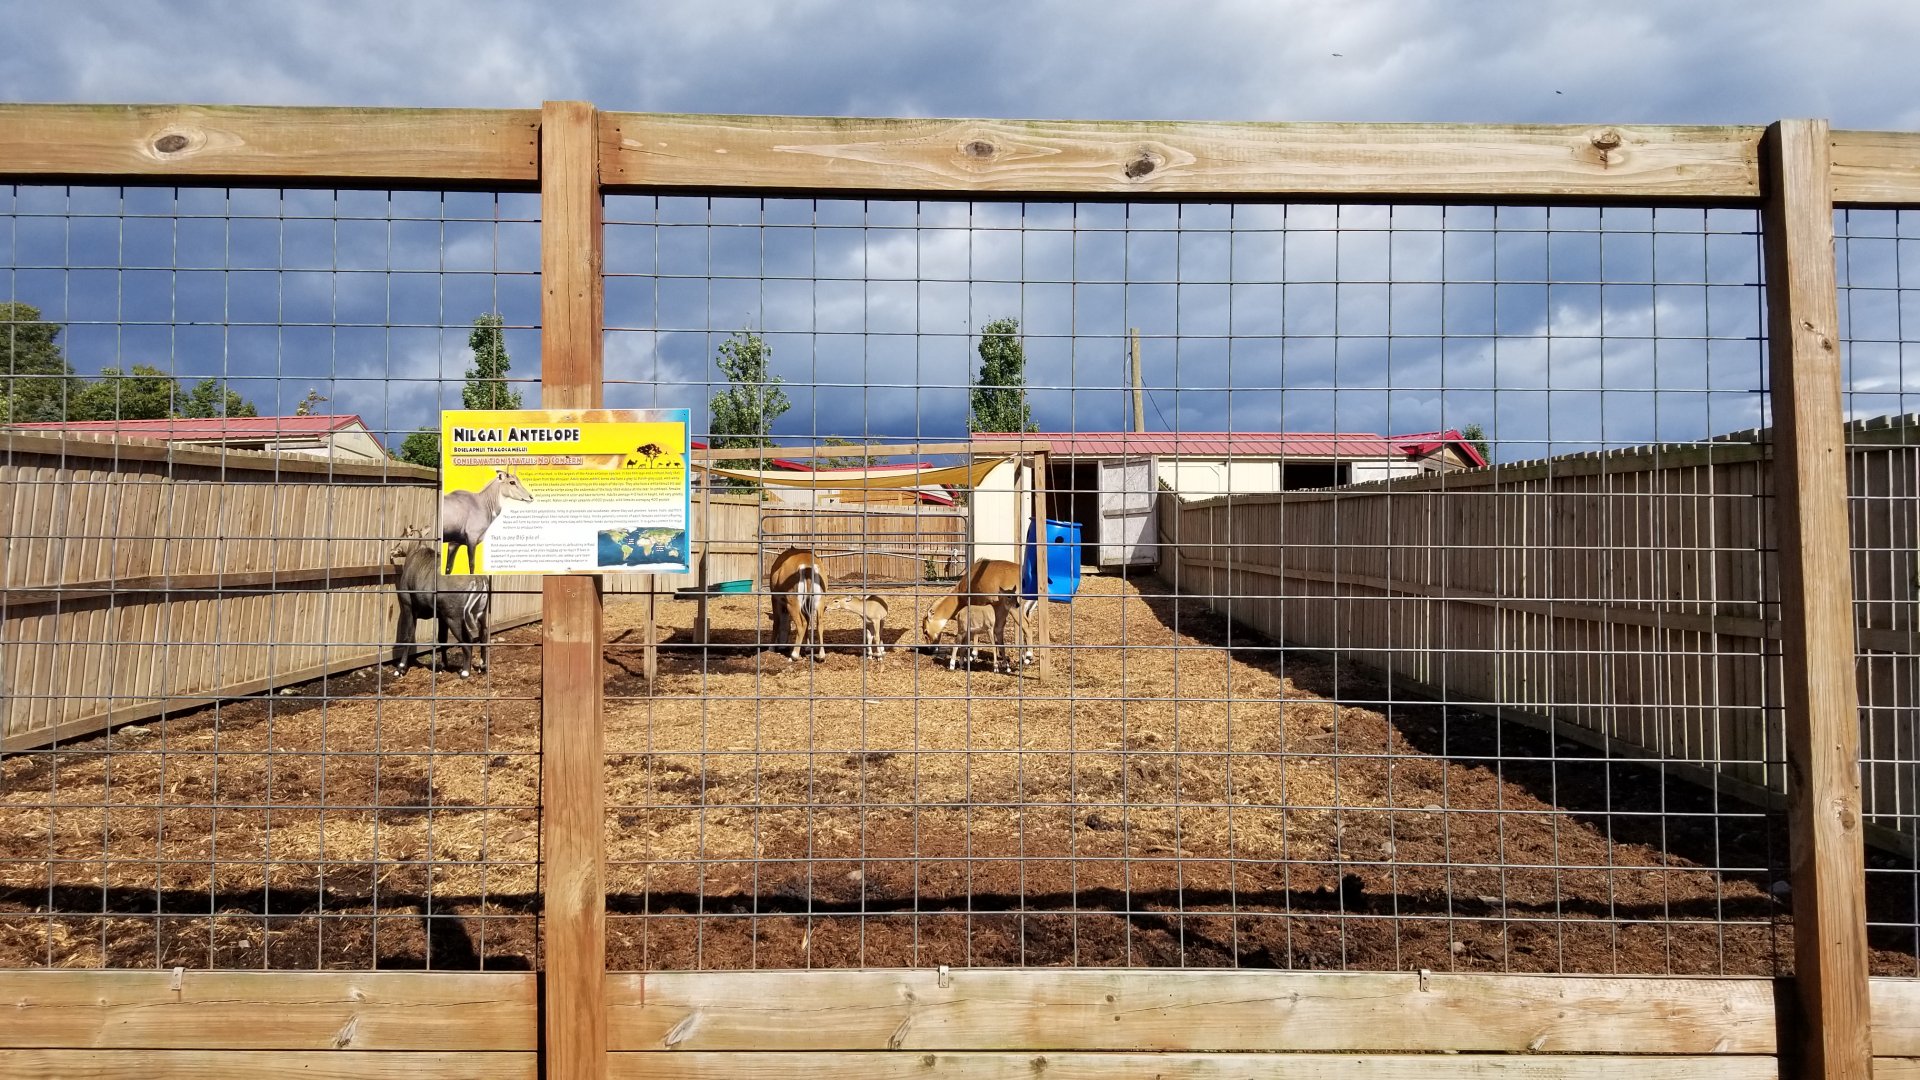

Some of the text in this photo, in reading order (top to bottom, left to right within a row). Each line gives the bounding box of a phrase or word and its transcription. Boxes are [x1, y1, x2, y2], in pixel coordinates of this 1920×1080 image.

[454, 427, 579, 442] NILGAI ANTELOPE
[453, 457, 507, 466] CONSERVATION
[537, 457, 551, 466] NO
[551, 457, 583, 466] CONCERN
